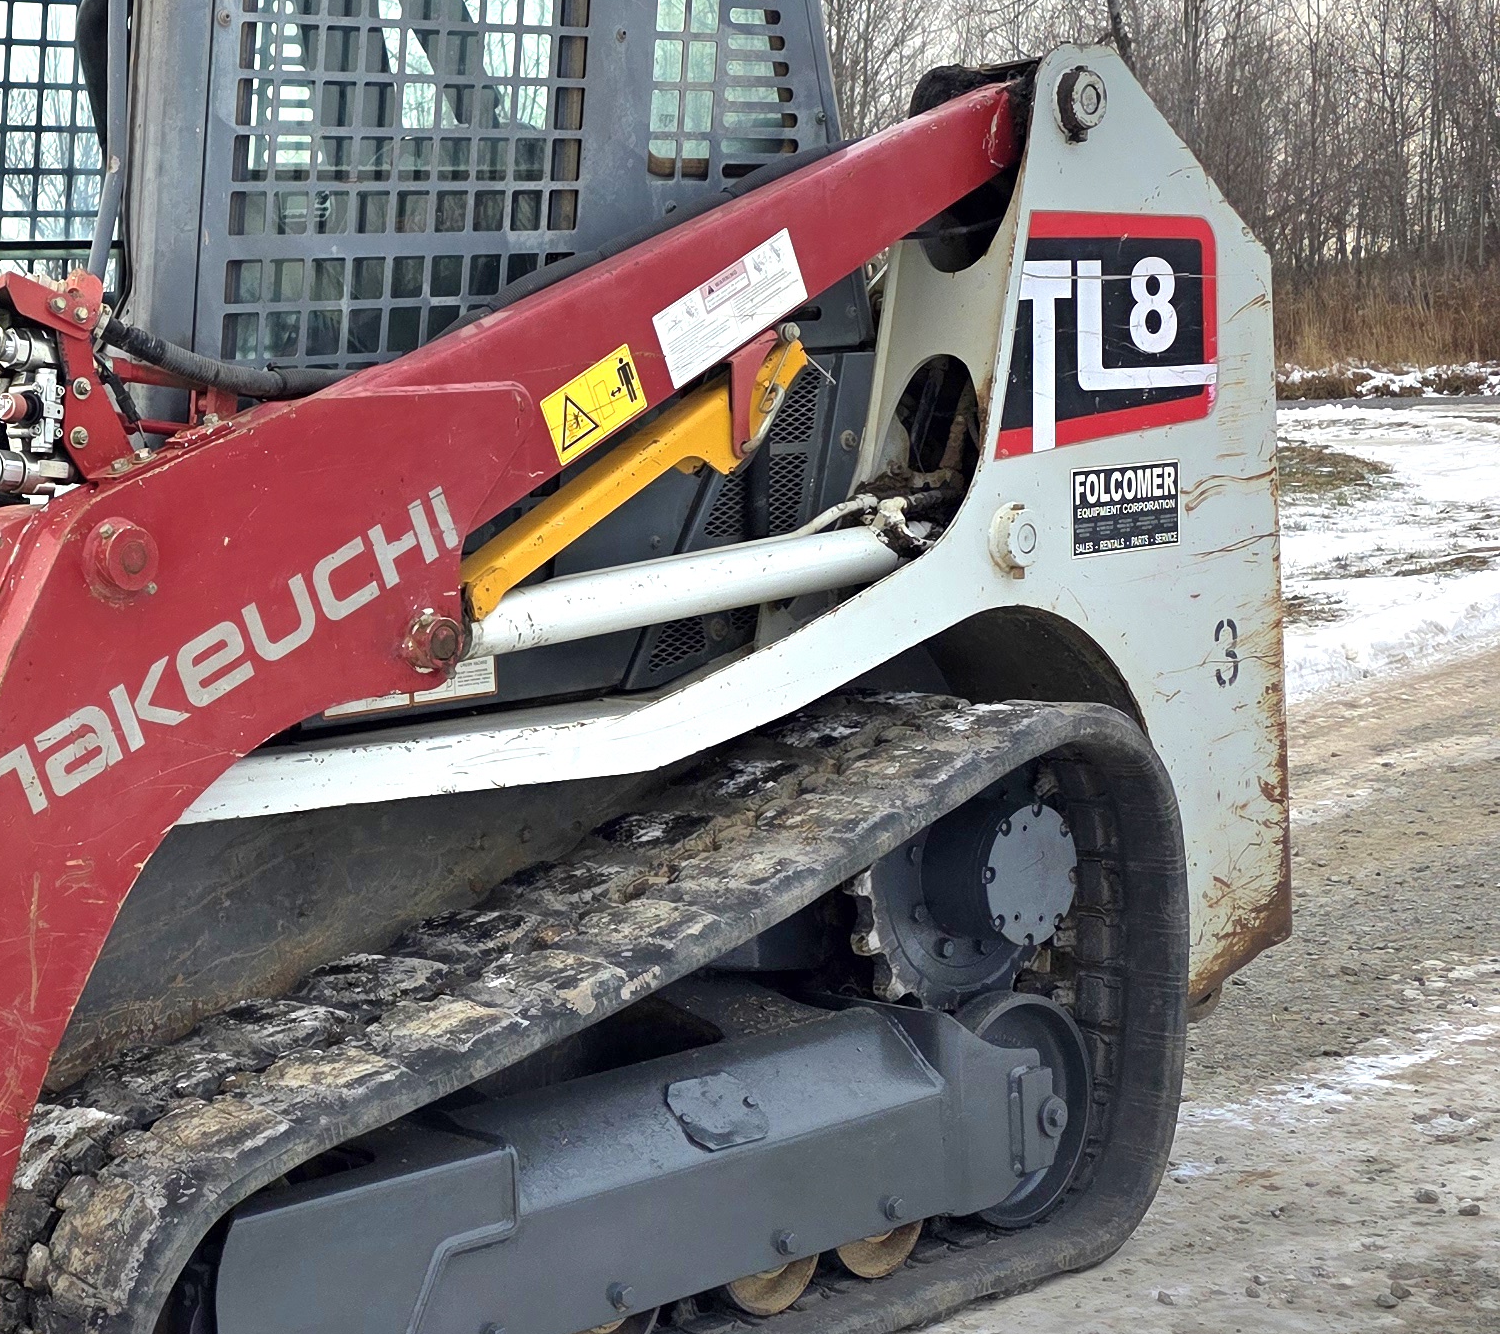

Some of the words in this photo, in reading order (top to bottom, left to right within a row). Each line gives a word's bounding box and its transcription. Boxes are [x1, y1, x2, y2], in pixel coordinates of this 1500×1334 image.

[1018, 256, 1218, 453] TL8
[1075, 466, 1176, 506] FOLCOMER
[1077, 505, 1121, 518] EQUIPMENT
[1122, 499, 1176, 513] CORPORATION
[1075, 542, 1094, 554] SALES
[1099, 538, 1125, 550] RENTALS
[1131, 535, 1149, 547] PARTS
[1155, 531, 1178, 543] SERVICE
